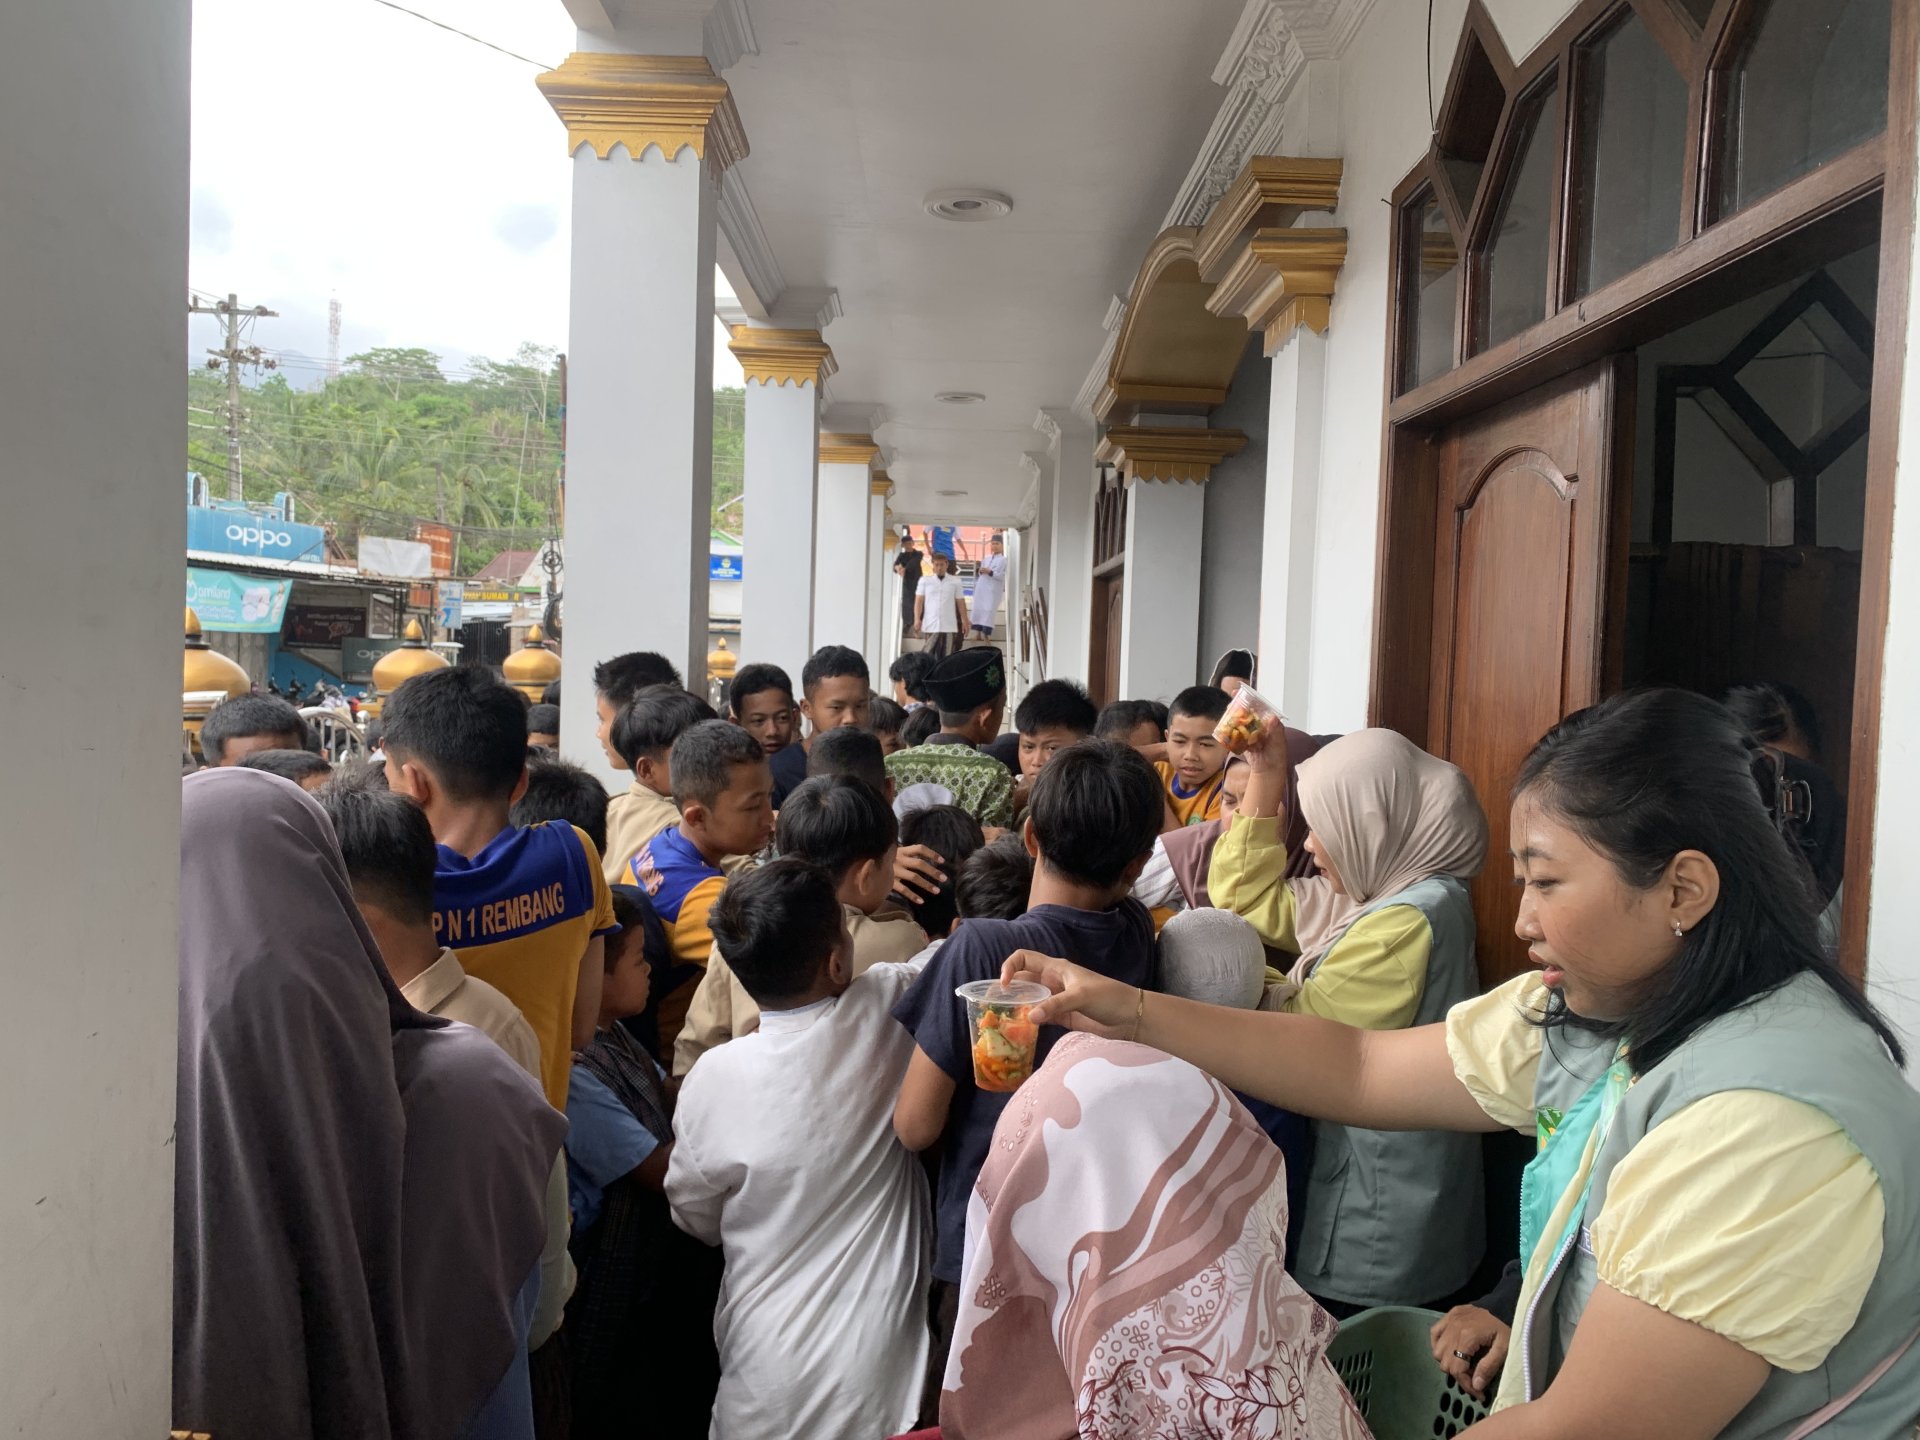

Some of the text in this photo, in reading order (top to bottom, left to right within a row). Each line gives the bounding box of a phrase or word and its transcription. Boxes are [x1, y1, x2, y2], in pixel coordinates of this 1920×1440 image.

[448, 909, 462, 941] N
[467, 908, 476, 938] 1
[482, 882, 565, 936] REMBANG
